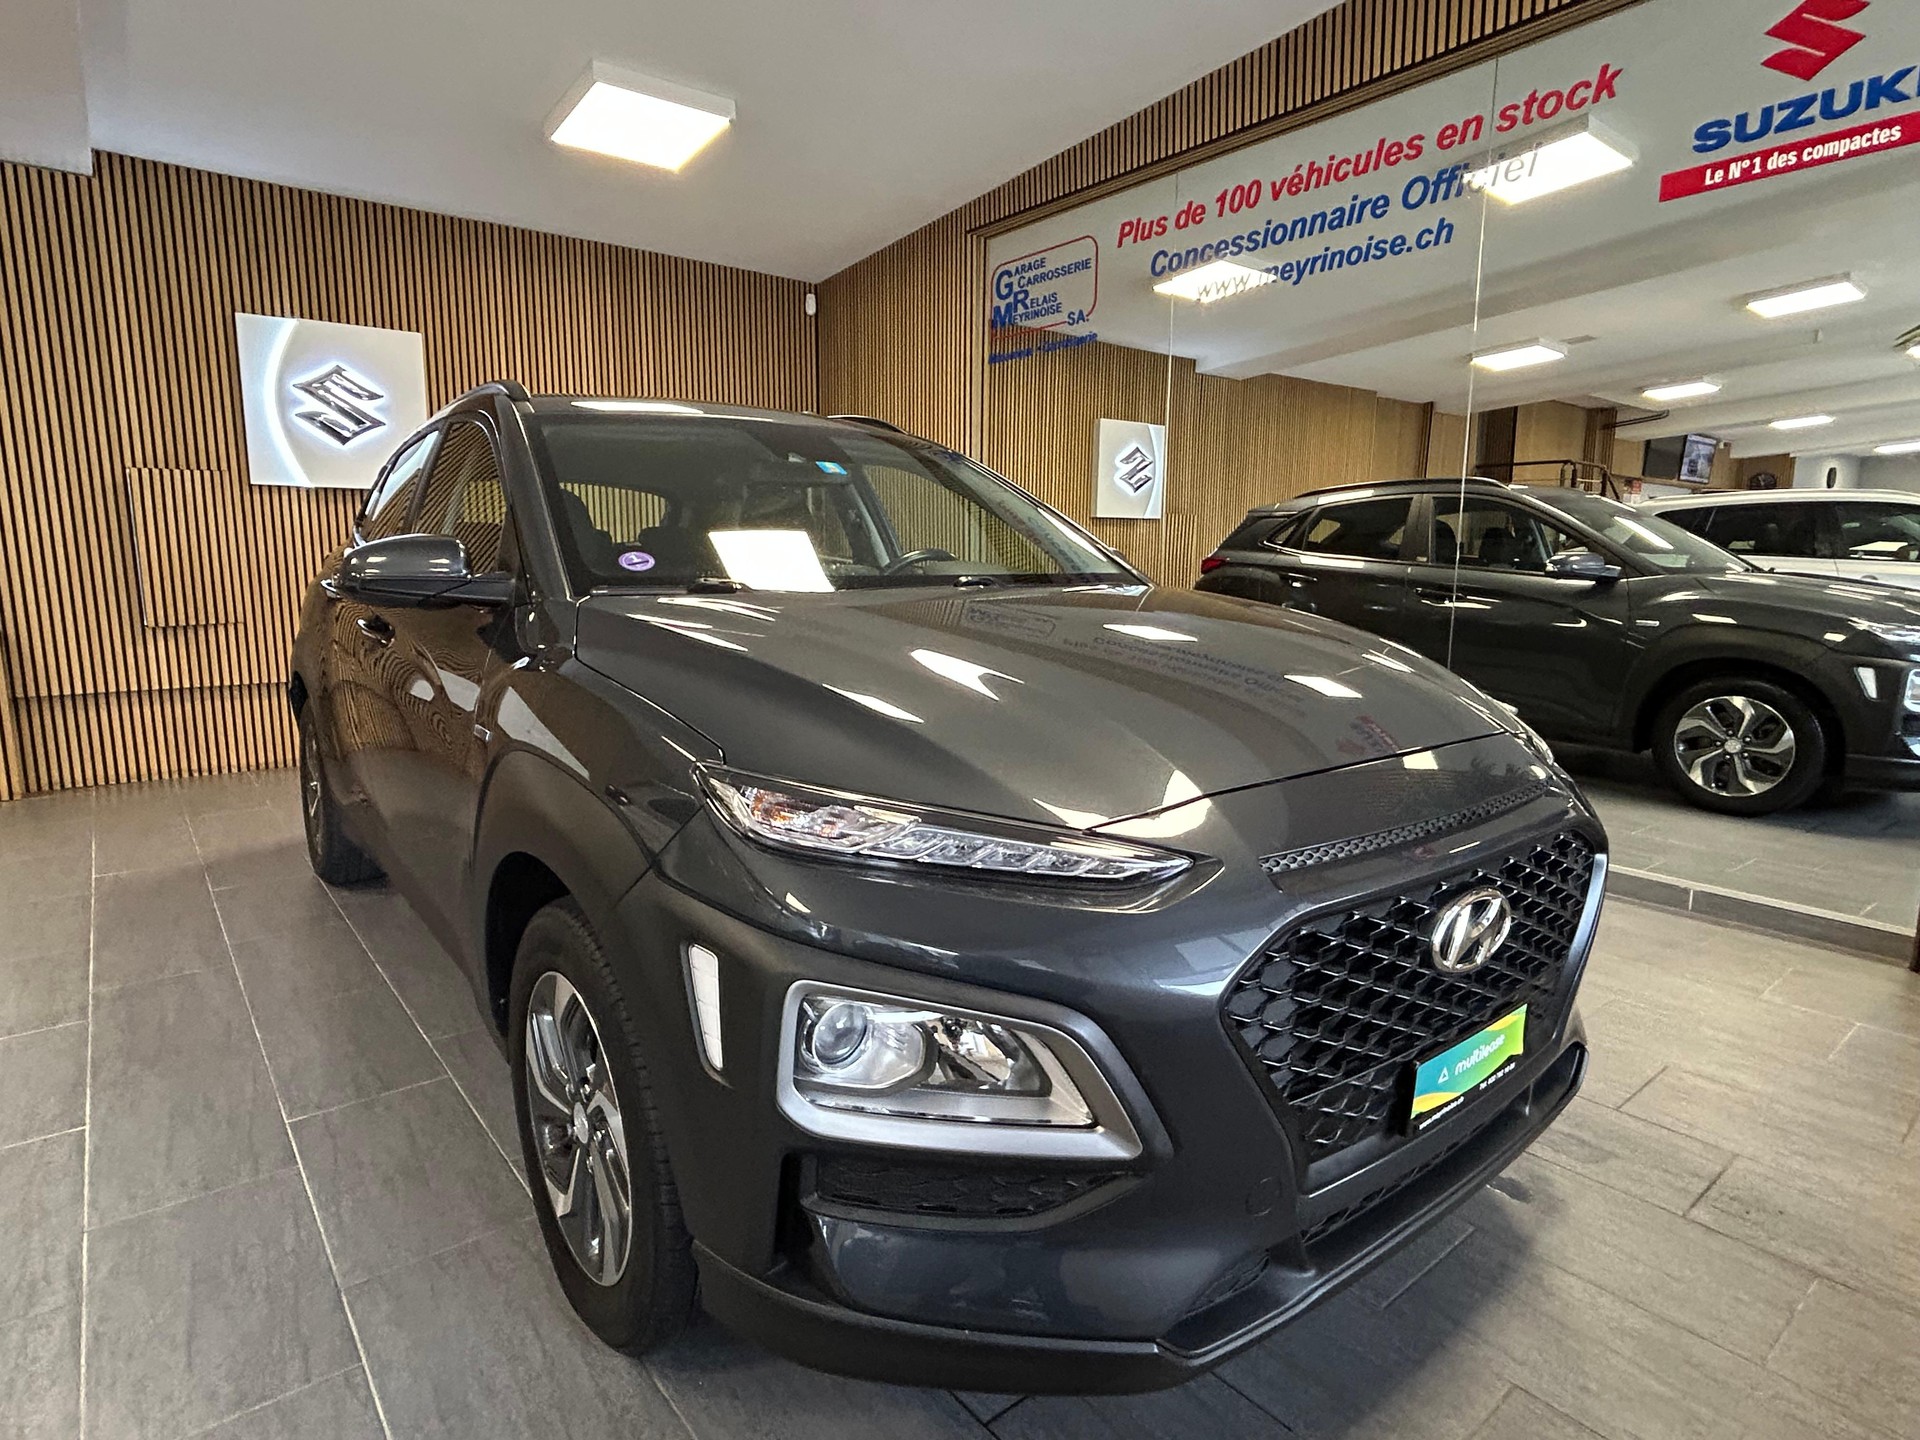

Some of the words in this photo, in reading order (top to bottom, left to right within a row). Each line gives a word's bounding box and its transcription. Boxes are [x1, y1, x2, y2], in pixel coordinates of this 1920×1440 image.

[1692, 65, 1920, 153] SUZUK
[1117, 216, 1168, 248] Plus
[1174, 200, 1206, 230] de
[1216, 179, 1263, 217] 100
[1270, 130, 1425, 203] véhicules
[1436, 112, 1485, 150] en
[1496, 63, 1624, 132] stock
[1704, 168, 1724, 186] Le
[1767, 149, 1798, 171] des
[1802, 124, 1902, 162] compactes
[1017, 257, 1092, 289] CARROSSERIE
[1150, 190, 1390, 278] Concessionnaire
